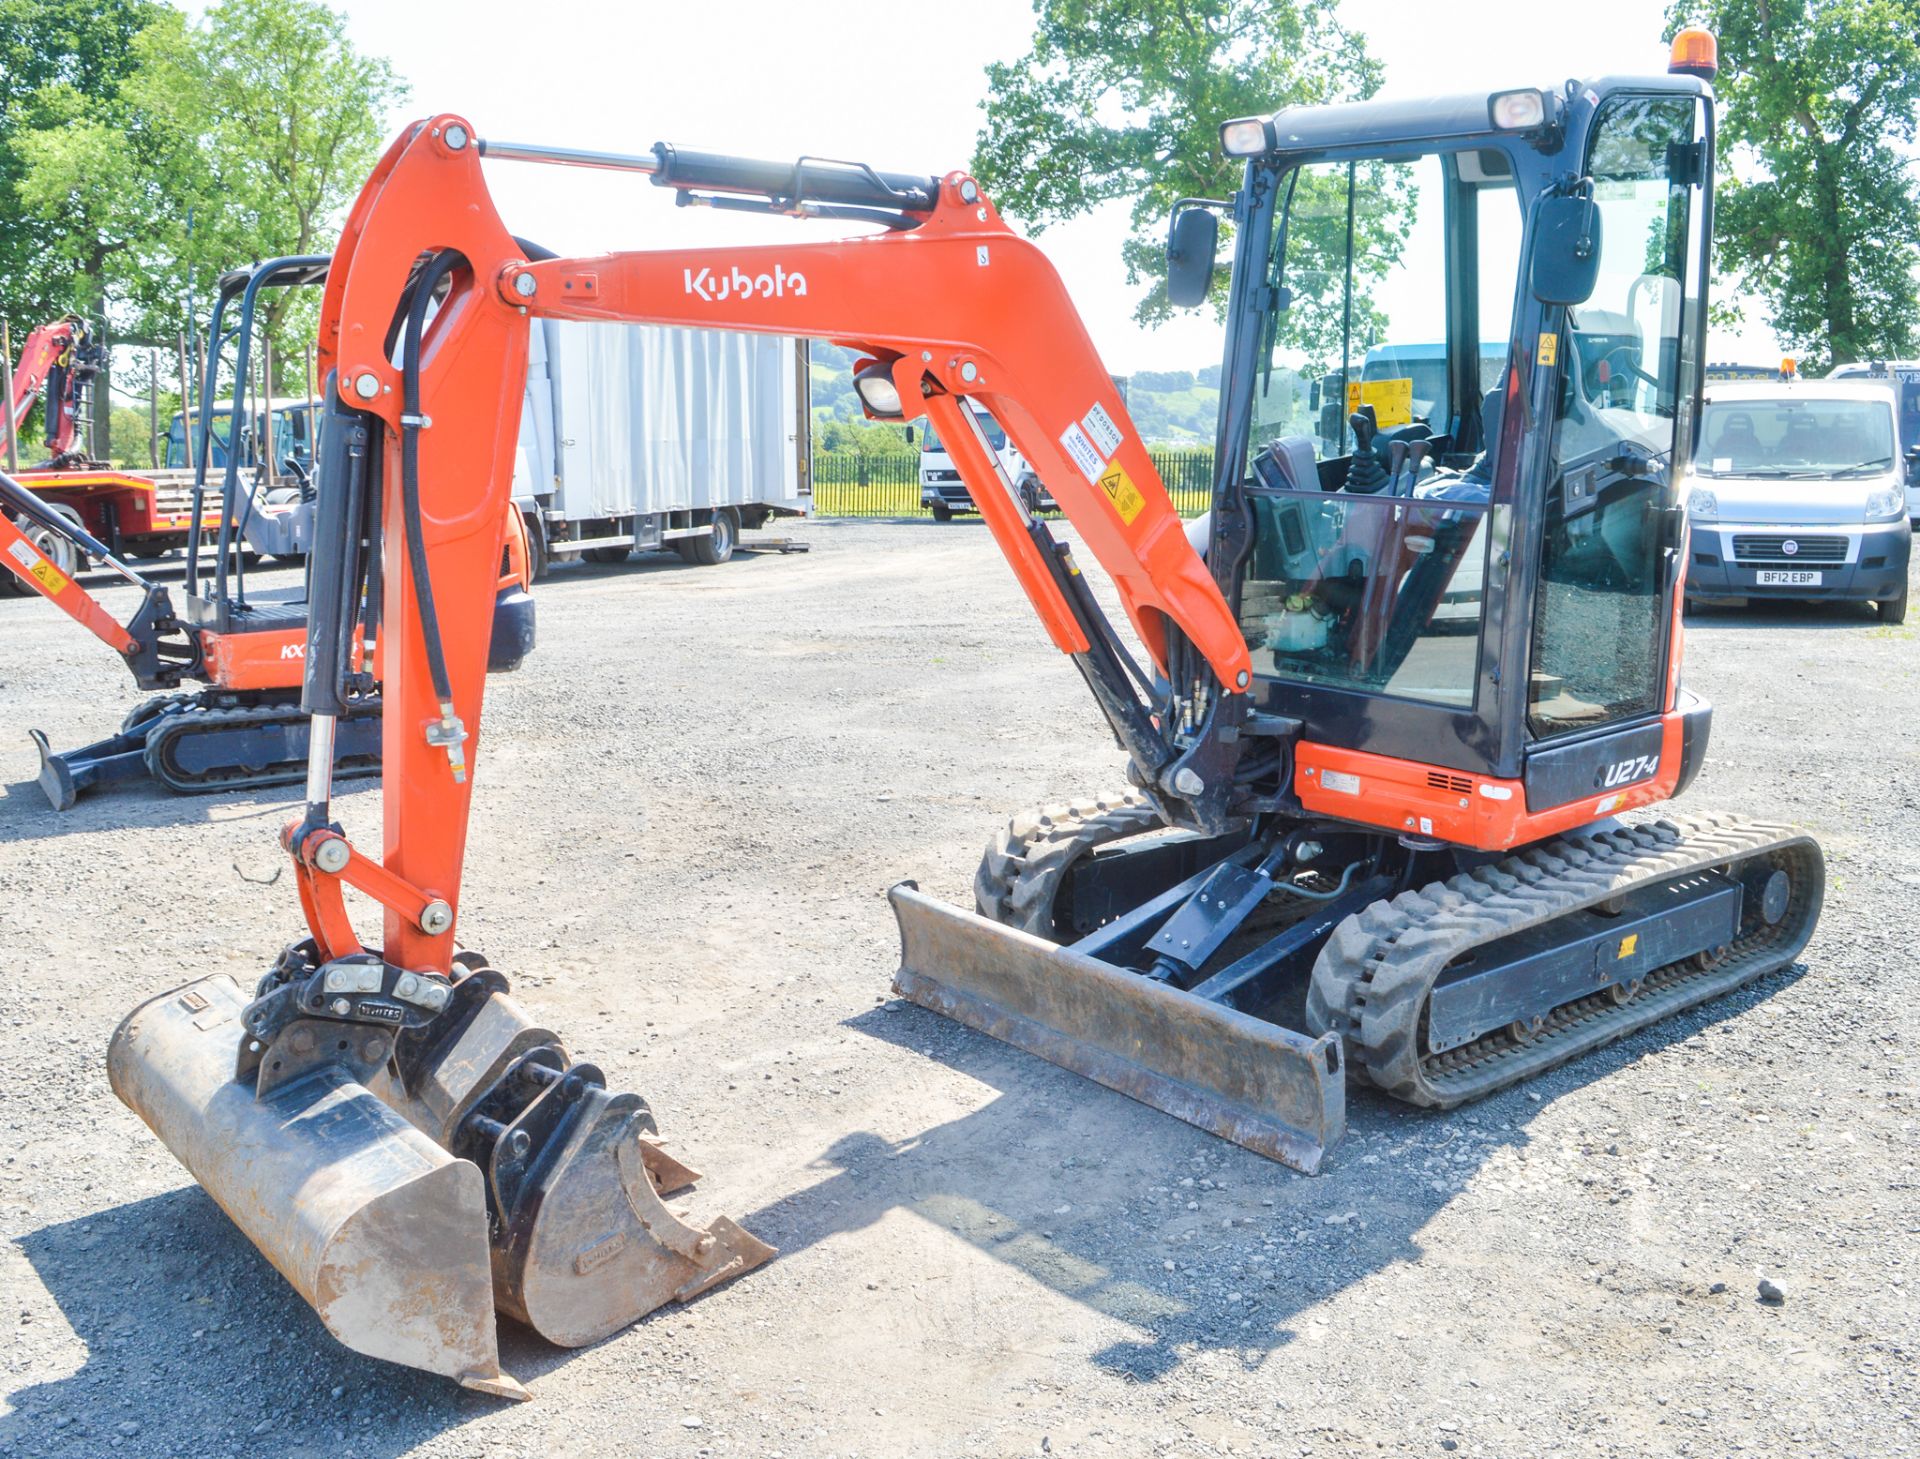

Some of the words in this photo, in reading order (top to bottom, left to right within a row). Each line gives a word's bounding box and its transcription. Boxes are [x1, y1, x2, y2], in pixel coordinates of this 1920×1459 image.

[684, 264, 807, 301] Kubota
[1075, 432, 1098, 465] WHITES
[1763, 572, 1789, 584] BF12
[1791, 572, 1814, 584] EBP
